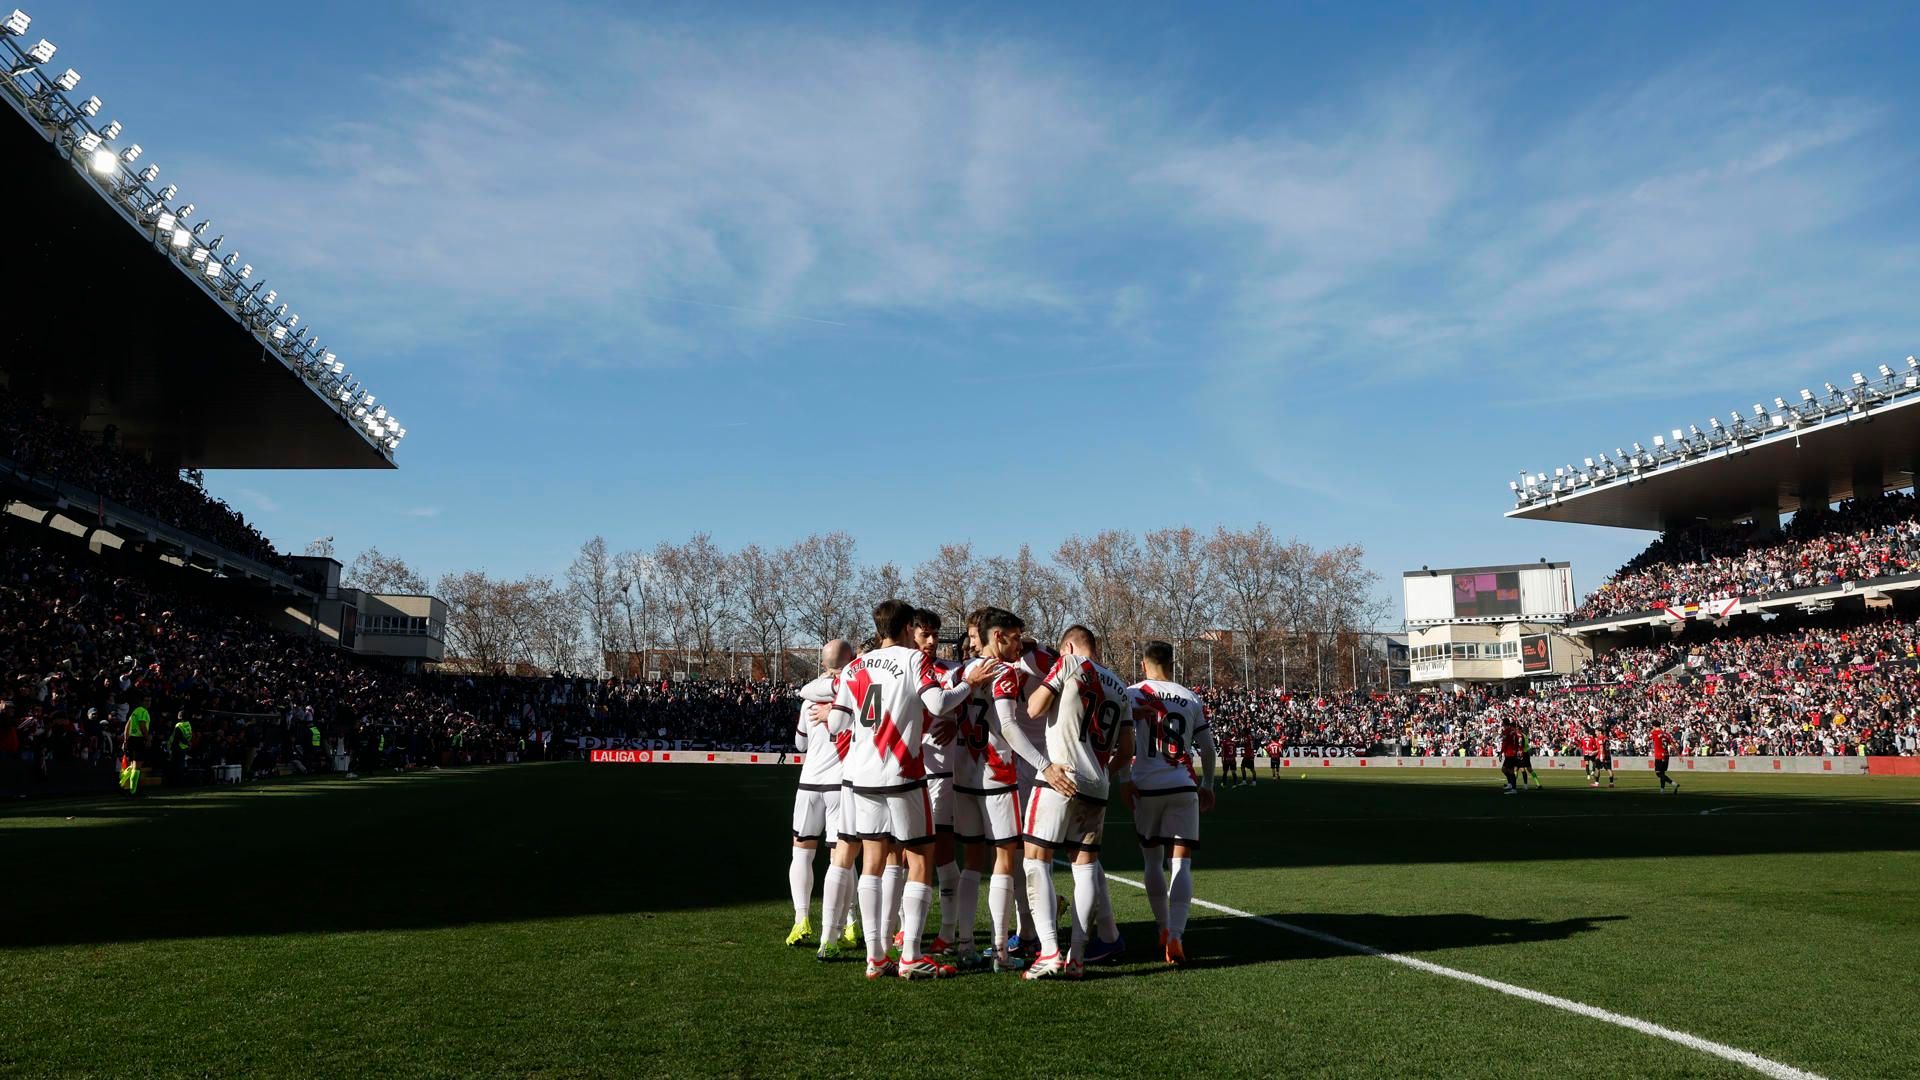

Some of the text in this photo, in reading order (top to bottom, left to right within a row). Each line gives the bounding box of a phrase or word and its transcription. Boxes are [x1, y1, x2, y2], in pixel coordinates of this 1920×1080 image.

[846, 658, 904, 679] PEDRO DÍAZ
[860, 683, 882, 728] 4
[1079, 691, 1121, 751] 19
[593, 751, 636, 762] LALIGA
[1148, 712, 1186, 760] 18
